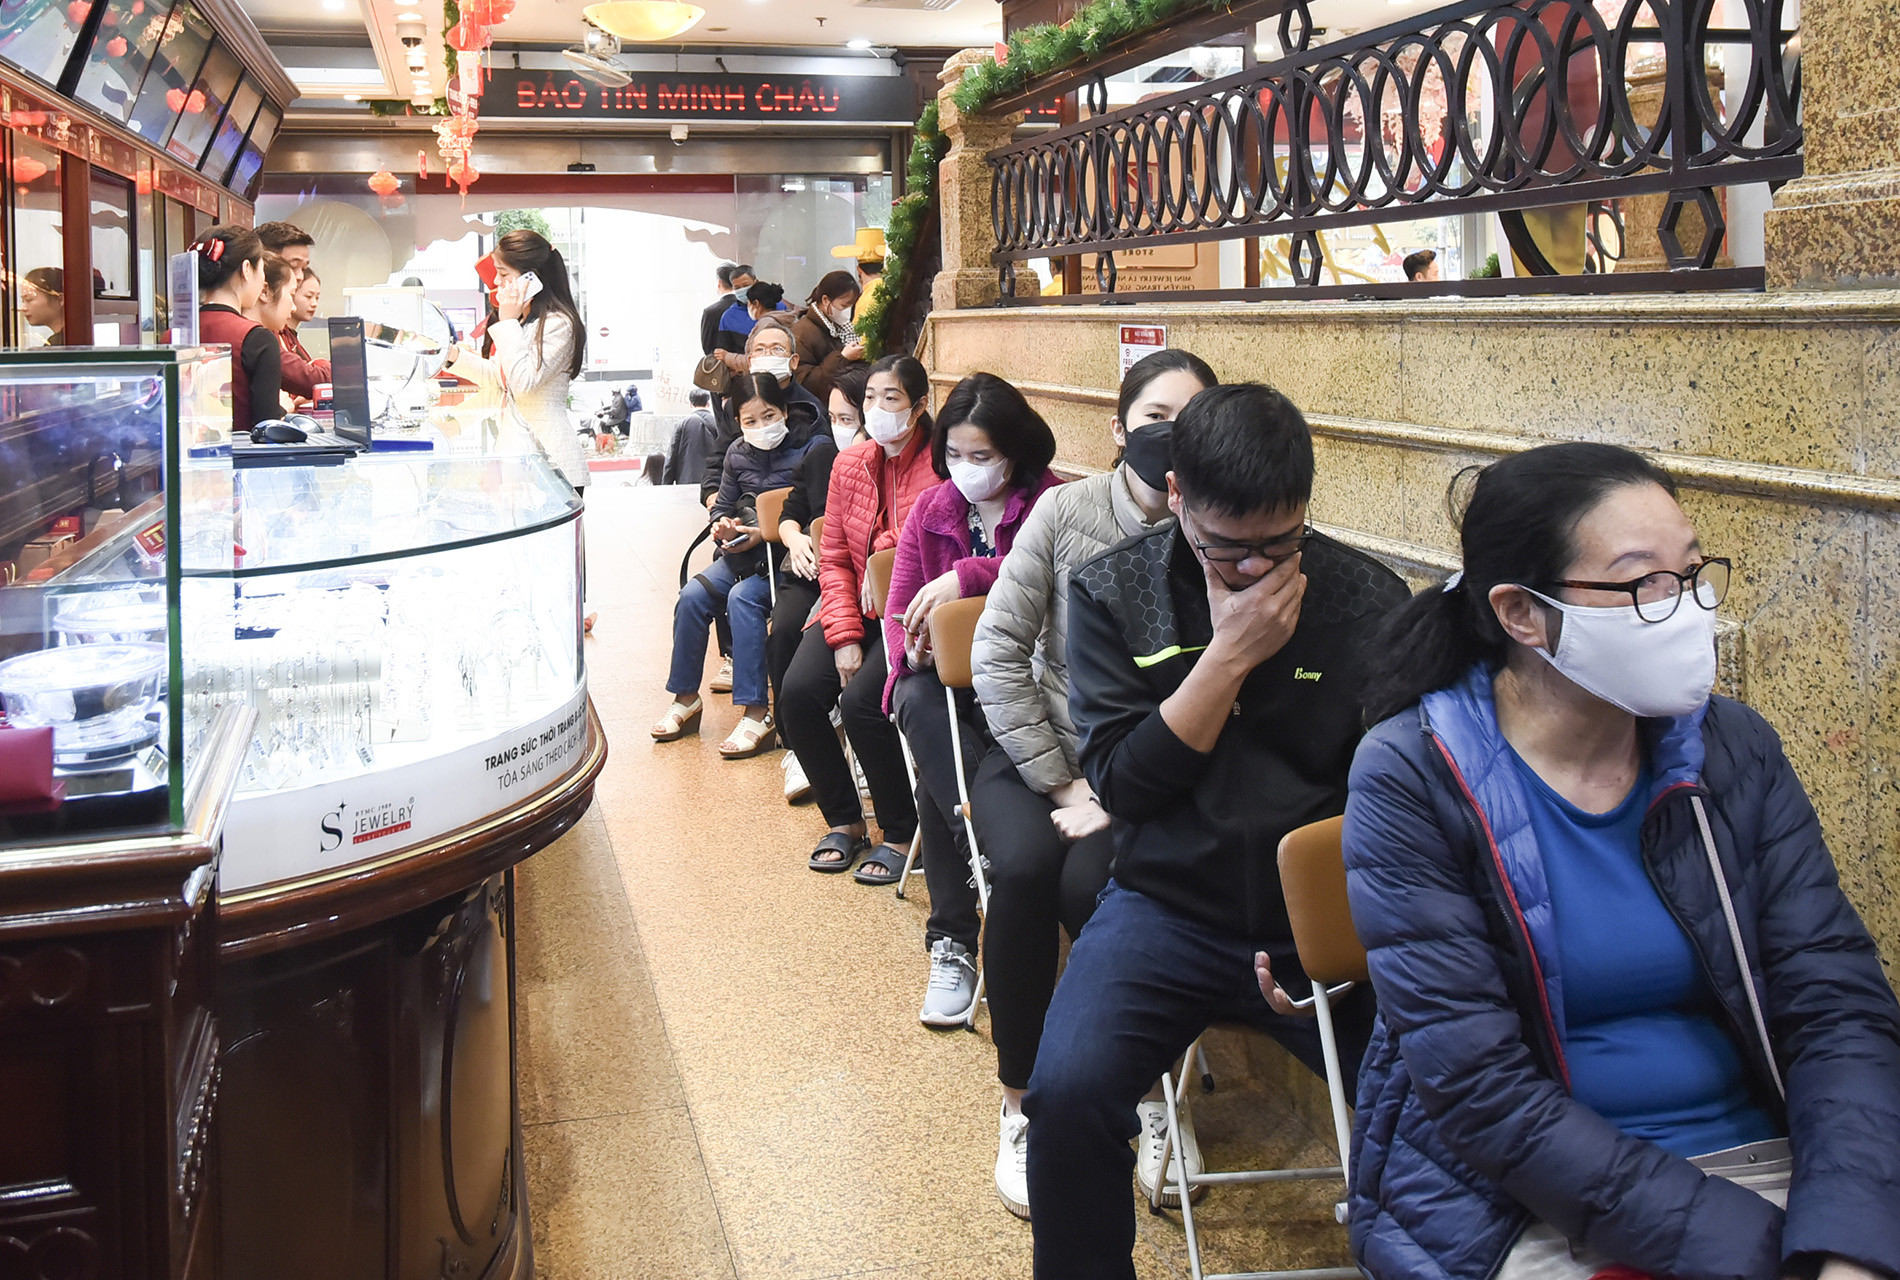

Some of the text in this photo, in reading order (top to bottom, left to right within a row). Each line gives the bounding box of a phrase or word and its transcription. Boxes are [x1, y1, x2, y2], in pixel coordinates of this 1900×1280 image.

[517, 71, 840, 112] BẢO TIN MINH CHÂU
[485, 746, 518, 771] TRANG
[520, 736, 538, 756] SỨC
[540, 725, 556, 747] THỜI
[557, 714, 574, 736] TRANG
[497, 768, 518, 790] TỎA
[520, 756, 544, 781] SÁNG
[545, 744, 563, 767] THEO
[352, 804, 414, 835] JEWELRY
[355, 802, 392, 817] BTMC 1989
[320, 811, 343, 853] S
